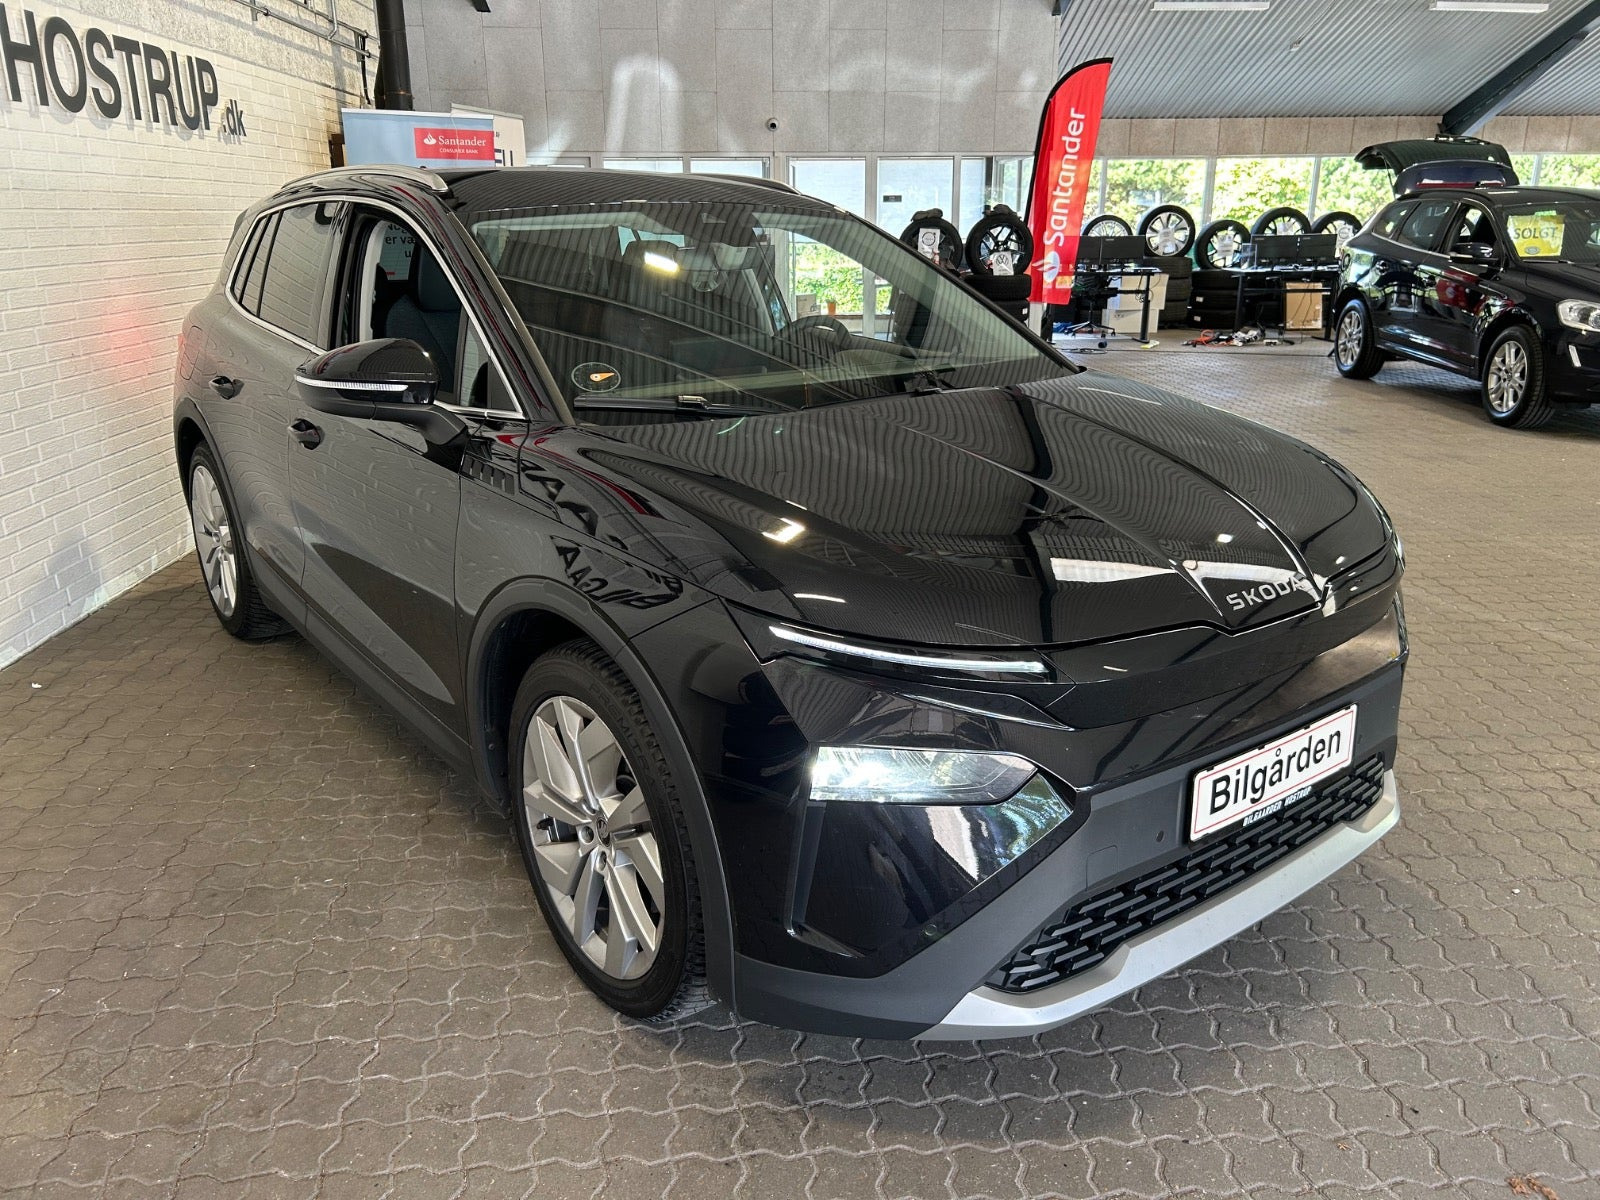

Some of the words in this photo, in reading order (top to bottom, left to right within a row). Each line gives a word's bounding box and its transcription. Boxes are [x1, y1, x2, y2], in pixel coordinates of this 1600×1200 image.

[438, 135, 486, 146] Santander
[1043, 107, 1086, 247] Santander
[1513, 227, 1559, 240] SOLGT
[1209, 730, 1341, 815] Bilgården
